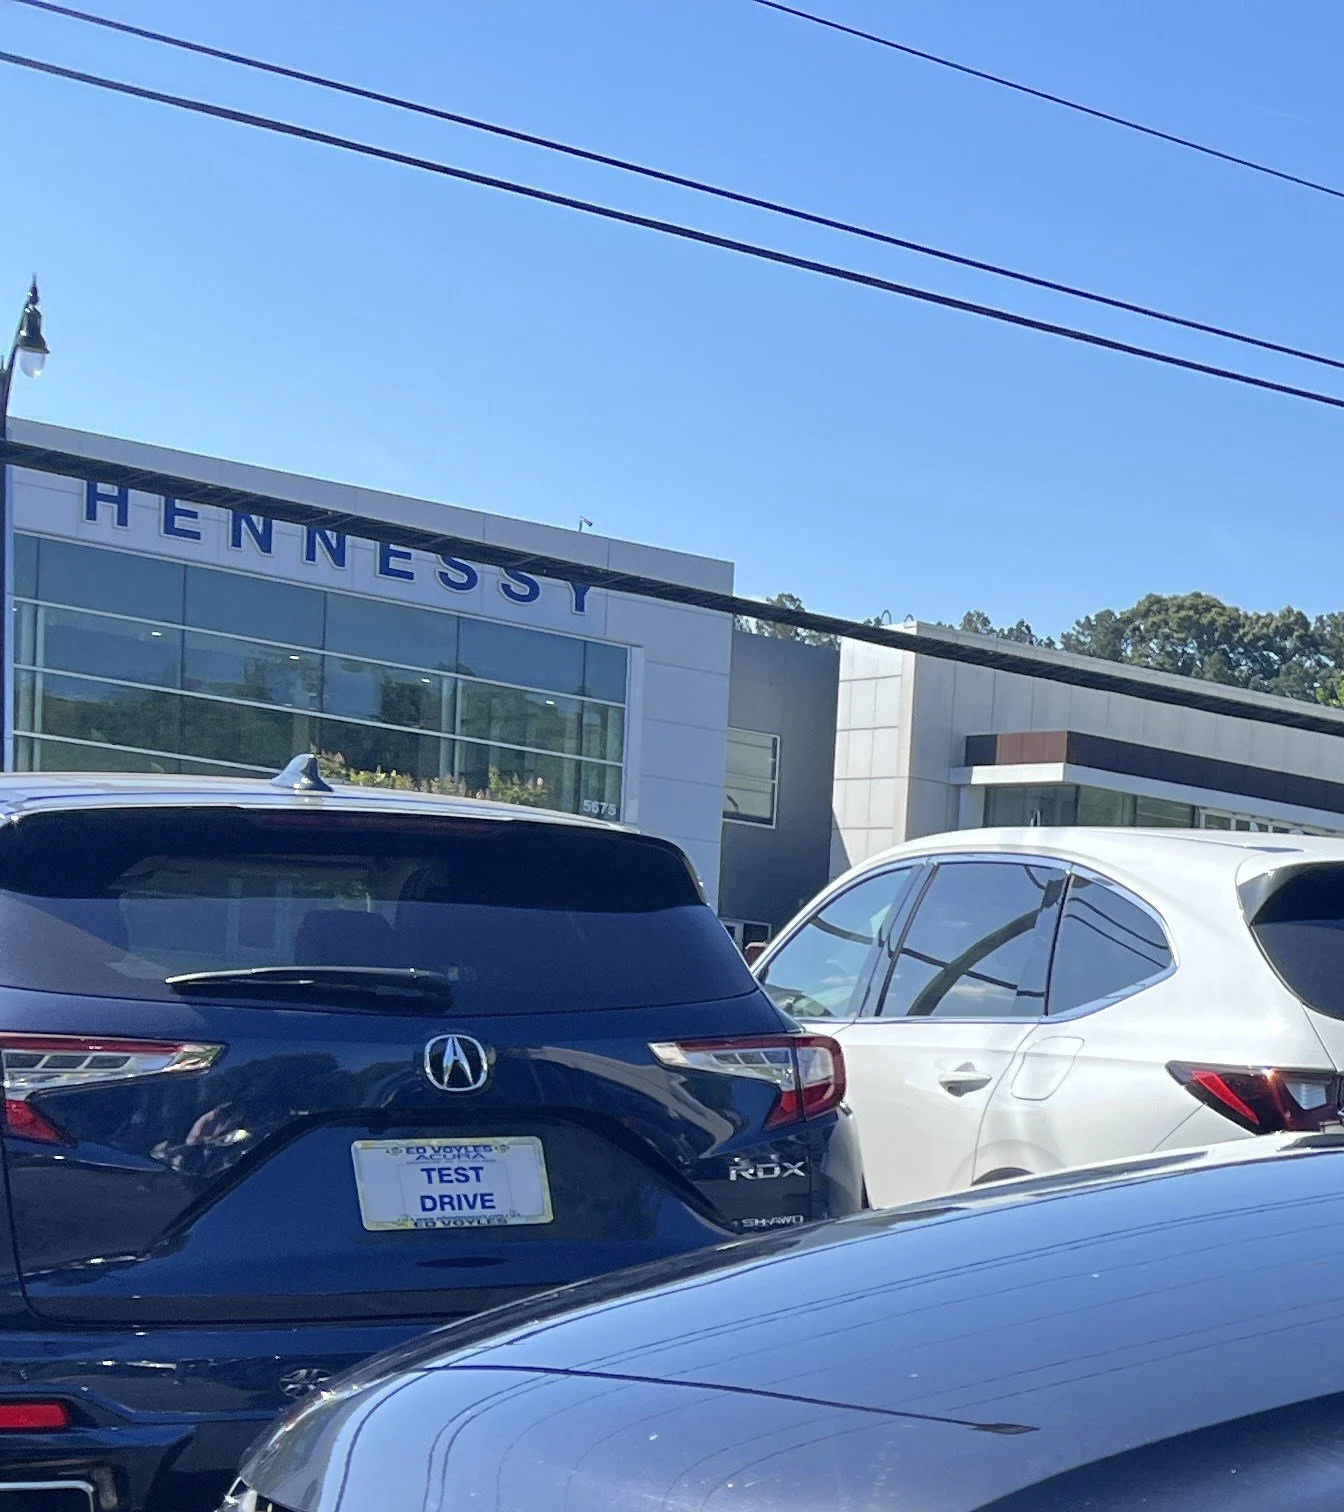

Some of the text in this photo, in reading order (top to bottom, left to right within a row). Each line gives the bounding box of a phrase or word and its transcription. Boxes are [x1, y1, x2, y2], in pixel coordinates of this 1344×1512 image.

[82, 478, 595, 615] HENNESSY
[420, 1165, 484, 1185] TEST
[729, 1161, 806, 1181] RDX
[419, 1192, 496, 1213] DRIVE
